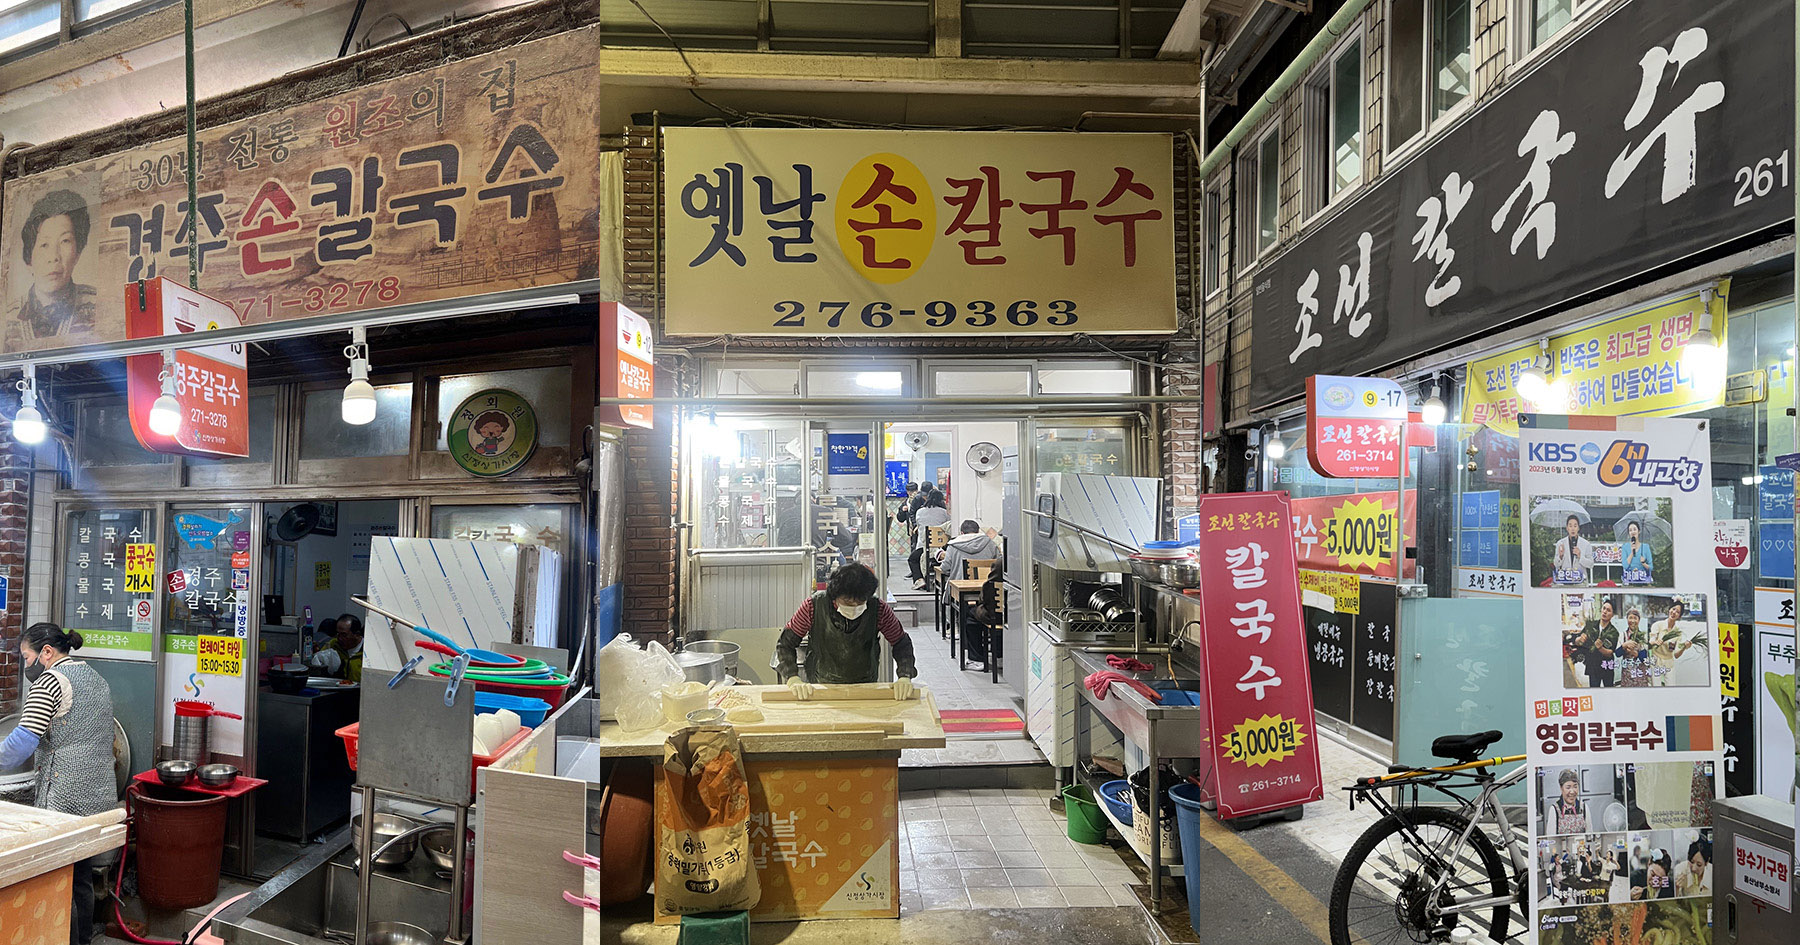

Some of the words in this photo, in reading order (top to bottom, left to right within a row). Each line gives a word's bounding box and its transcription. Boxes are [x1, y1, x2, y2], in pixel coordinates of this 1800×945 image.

[226, 118, 299, 172] 전통
[322, 77, 447, 149] 원조의
[478, 58, 518, 112] 집
[1288, 231, 1374, 365] 조선
[1412, 26, 1725, 308] 칼국수
[680, 162, 826, 268] 옛날
[847, 162, 923, 270] 손
[943, 165, 1163, 268] 칼국수
[225, 277, 400, 324] 71-3278
[772, 300, 1079, 329] 276-9363
[1485, 368, 1507, 394] 조선
[1560, 338, 1600, 376] 반죽은
[1605, 324, 1652, 364] 최고급
[1658, 311, 1694, 352] 생면
[1611, 360, 1696, 403] 만들었습니
[191, 408, 228, 429] 271-3278
[1321, 424, 1353, 443] 조선
[1336, 449, 1394, 462] 261-3714
[1529, 442, 1577, 463] KBS
[1529, 465, 1550, 474] 2023년
[1551, 466, 1562, 474] 6월
[1632, 458, 1699, 490] 내고향
[717, 514, 776, 528] 수제비
[1207, 514, 1236, 533] 조선
[1237, 511, 1281, 532] 칼국수
[1327, 512, 1393, 559] 5,000원
[127, 545, 155, 572] 콩국수
[126, 574, 155, 591] 개시
[169, 573, 184, 591] 손
[187, 565, 222, 588] 경주
[1468, 573, 1485, 589] 조선
[1488, 574, 1516, 593] 칼국수
[185, 589, 237, 613] 칼국수
[1777, 598, 1795, 620] 조
[1224, 542, 1283, 701] 칼국수
[1367, 621, 1391, 643] 칼국
[85, 633, 130, 646] 경주손칼국수
[171, 638, 198, 651] 경주손
[200, 638, 226, 656] 브레이크
[1718, 628, 1736, 659] 수
[200, 658, 240, 674] 15:00~15:30
[1719, 663, 1736, 691] 원
[1366, 678, 1395, 702] 장칼국
[1536, 696, 1593, 717] 명품맛집
[1231, 721, 1296, 761] 5,000원
[1536, 721, 1664, 755] 영희칼국수
[1252, 774, 1301, 792] 261-3714
[750, 810, 799, 838] 옛날
[1736, 846, 1788, 883] 방수기구함
